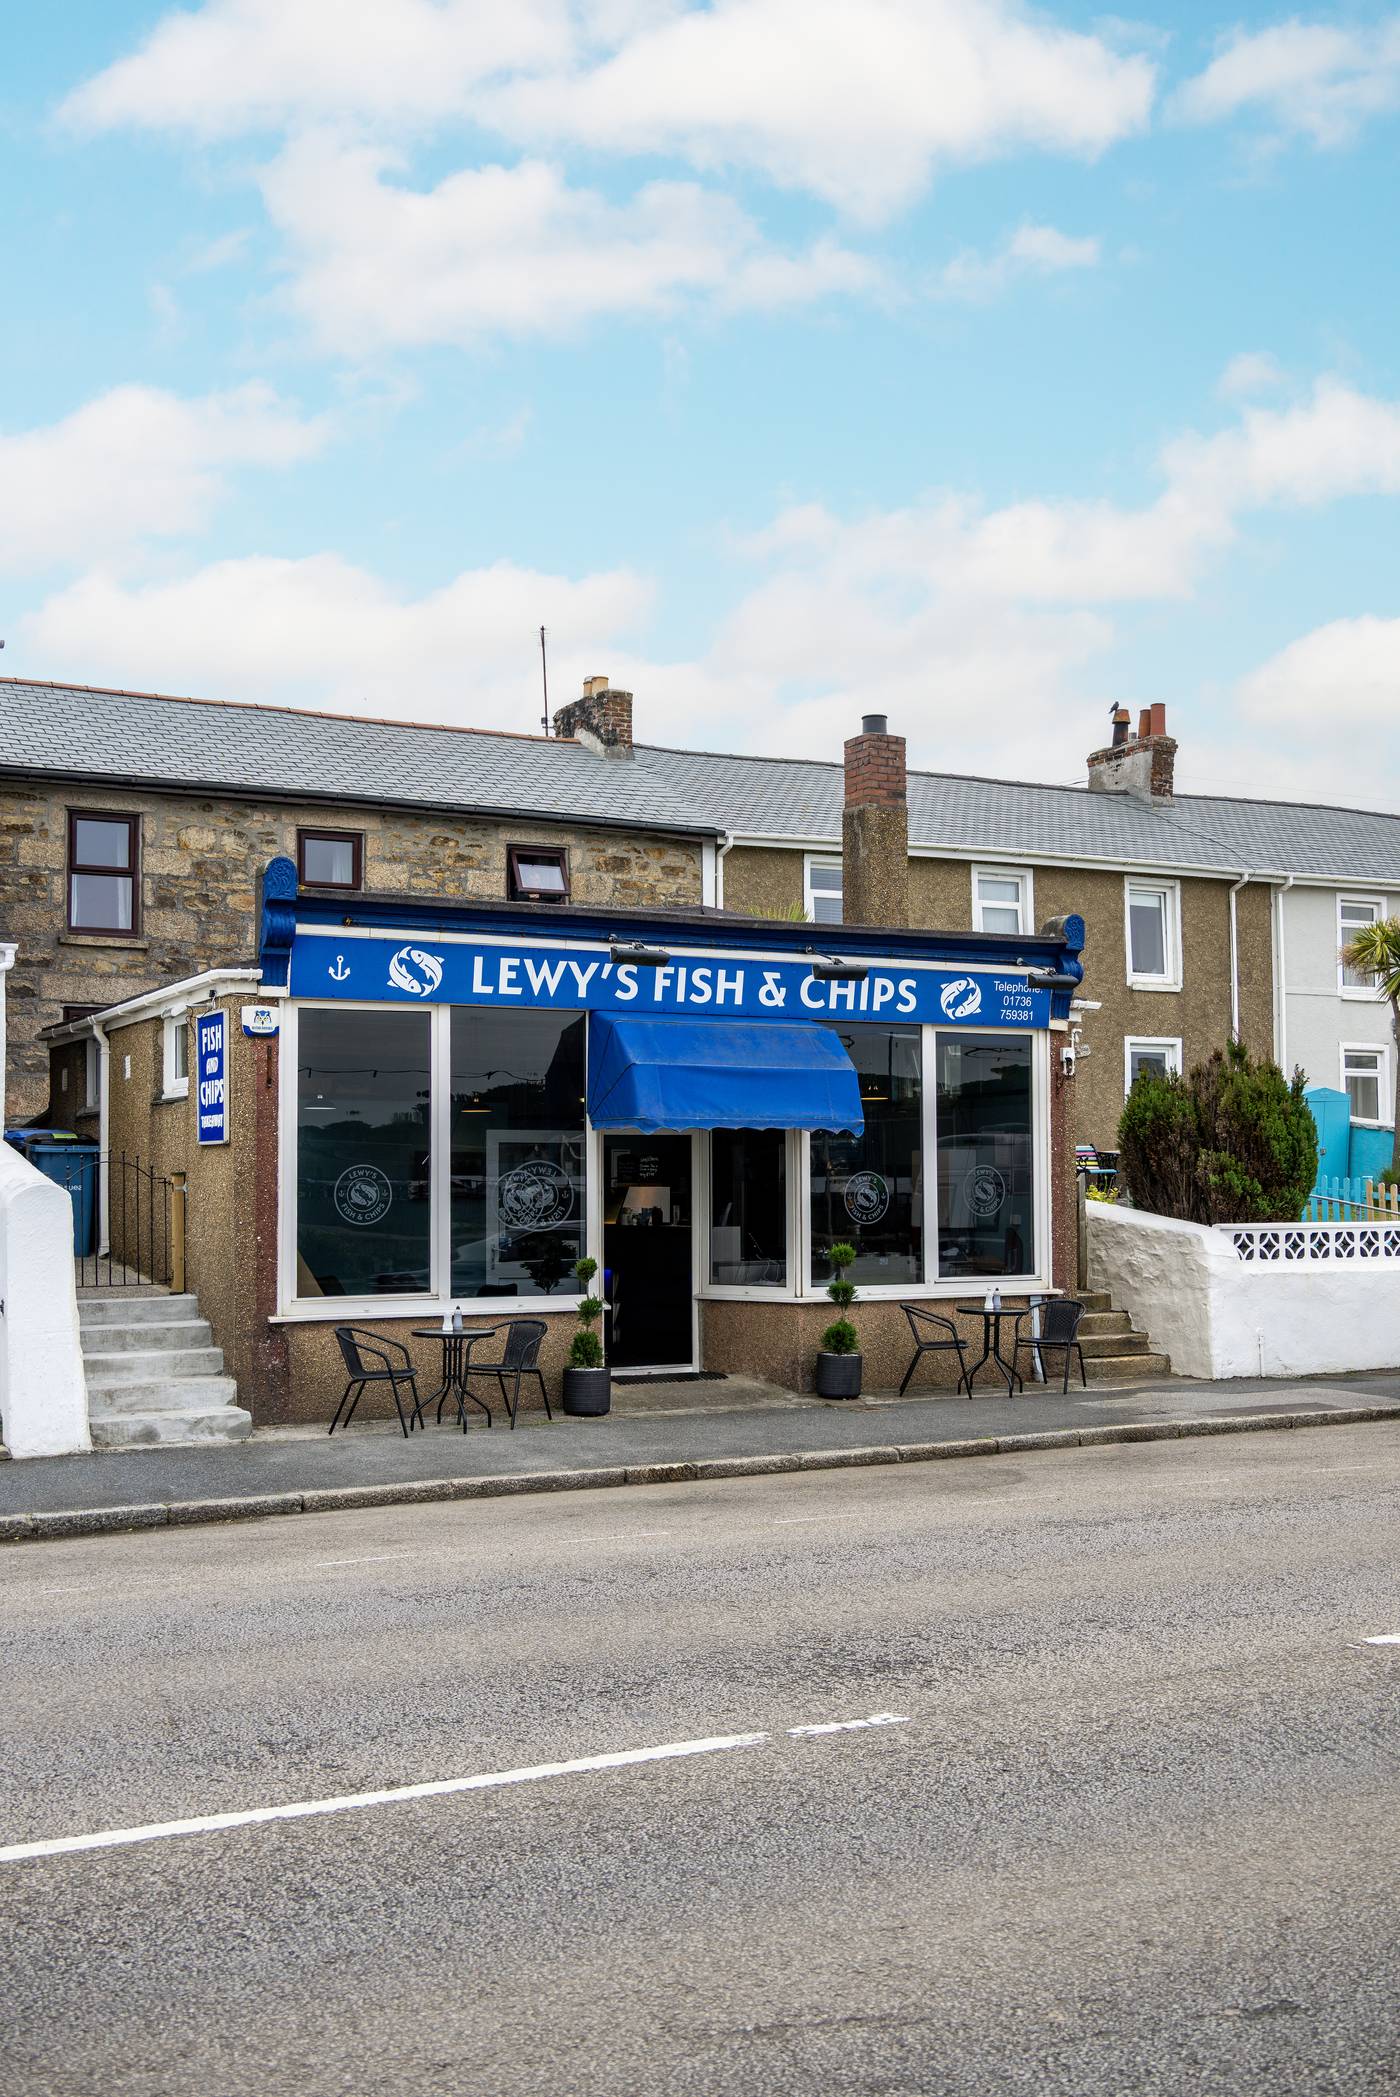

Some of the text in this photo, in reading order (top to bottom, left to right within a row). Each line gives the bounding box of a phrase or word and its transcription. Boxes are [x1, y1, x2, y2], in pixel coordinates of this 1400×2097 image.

[472, 956, 917, 1013] LEWY'S FISH & CHIPS
[1003, 995, 1032, 1007] 01736
[1000, 1009, 1033, 1021] 759381
[202, 1024, 222, 1055] FISH
[206, 1057, 219, 1076] AND
[200, 1078, 224, 1109] CHIPS
[348, 1169, 378, 1179] LEWY'S
[341, 1203, 356, 1218] FISH
[364, 1202, 385, 1220] CHIPS
